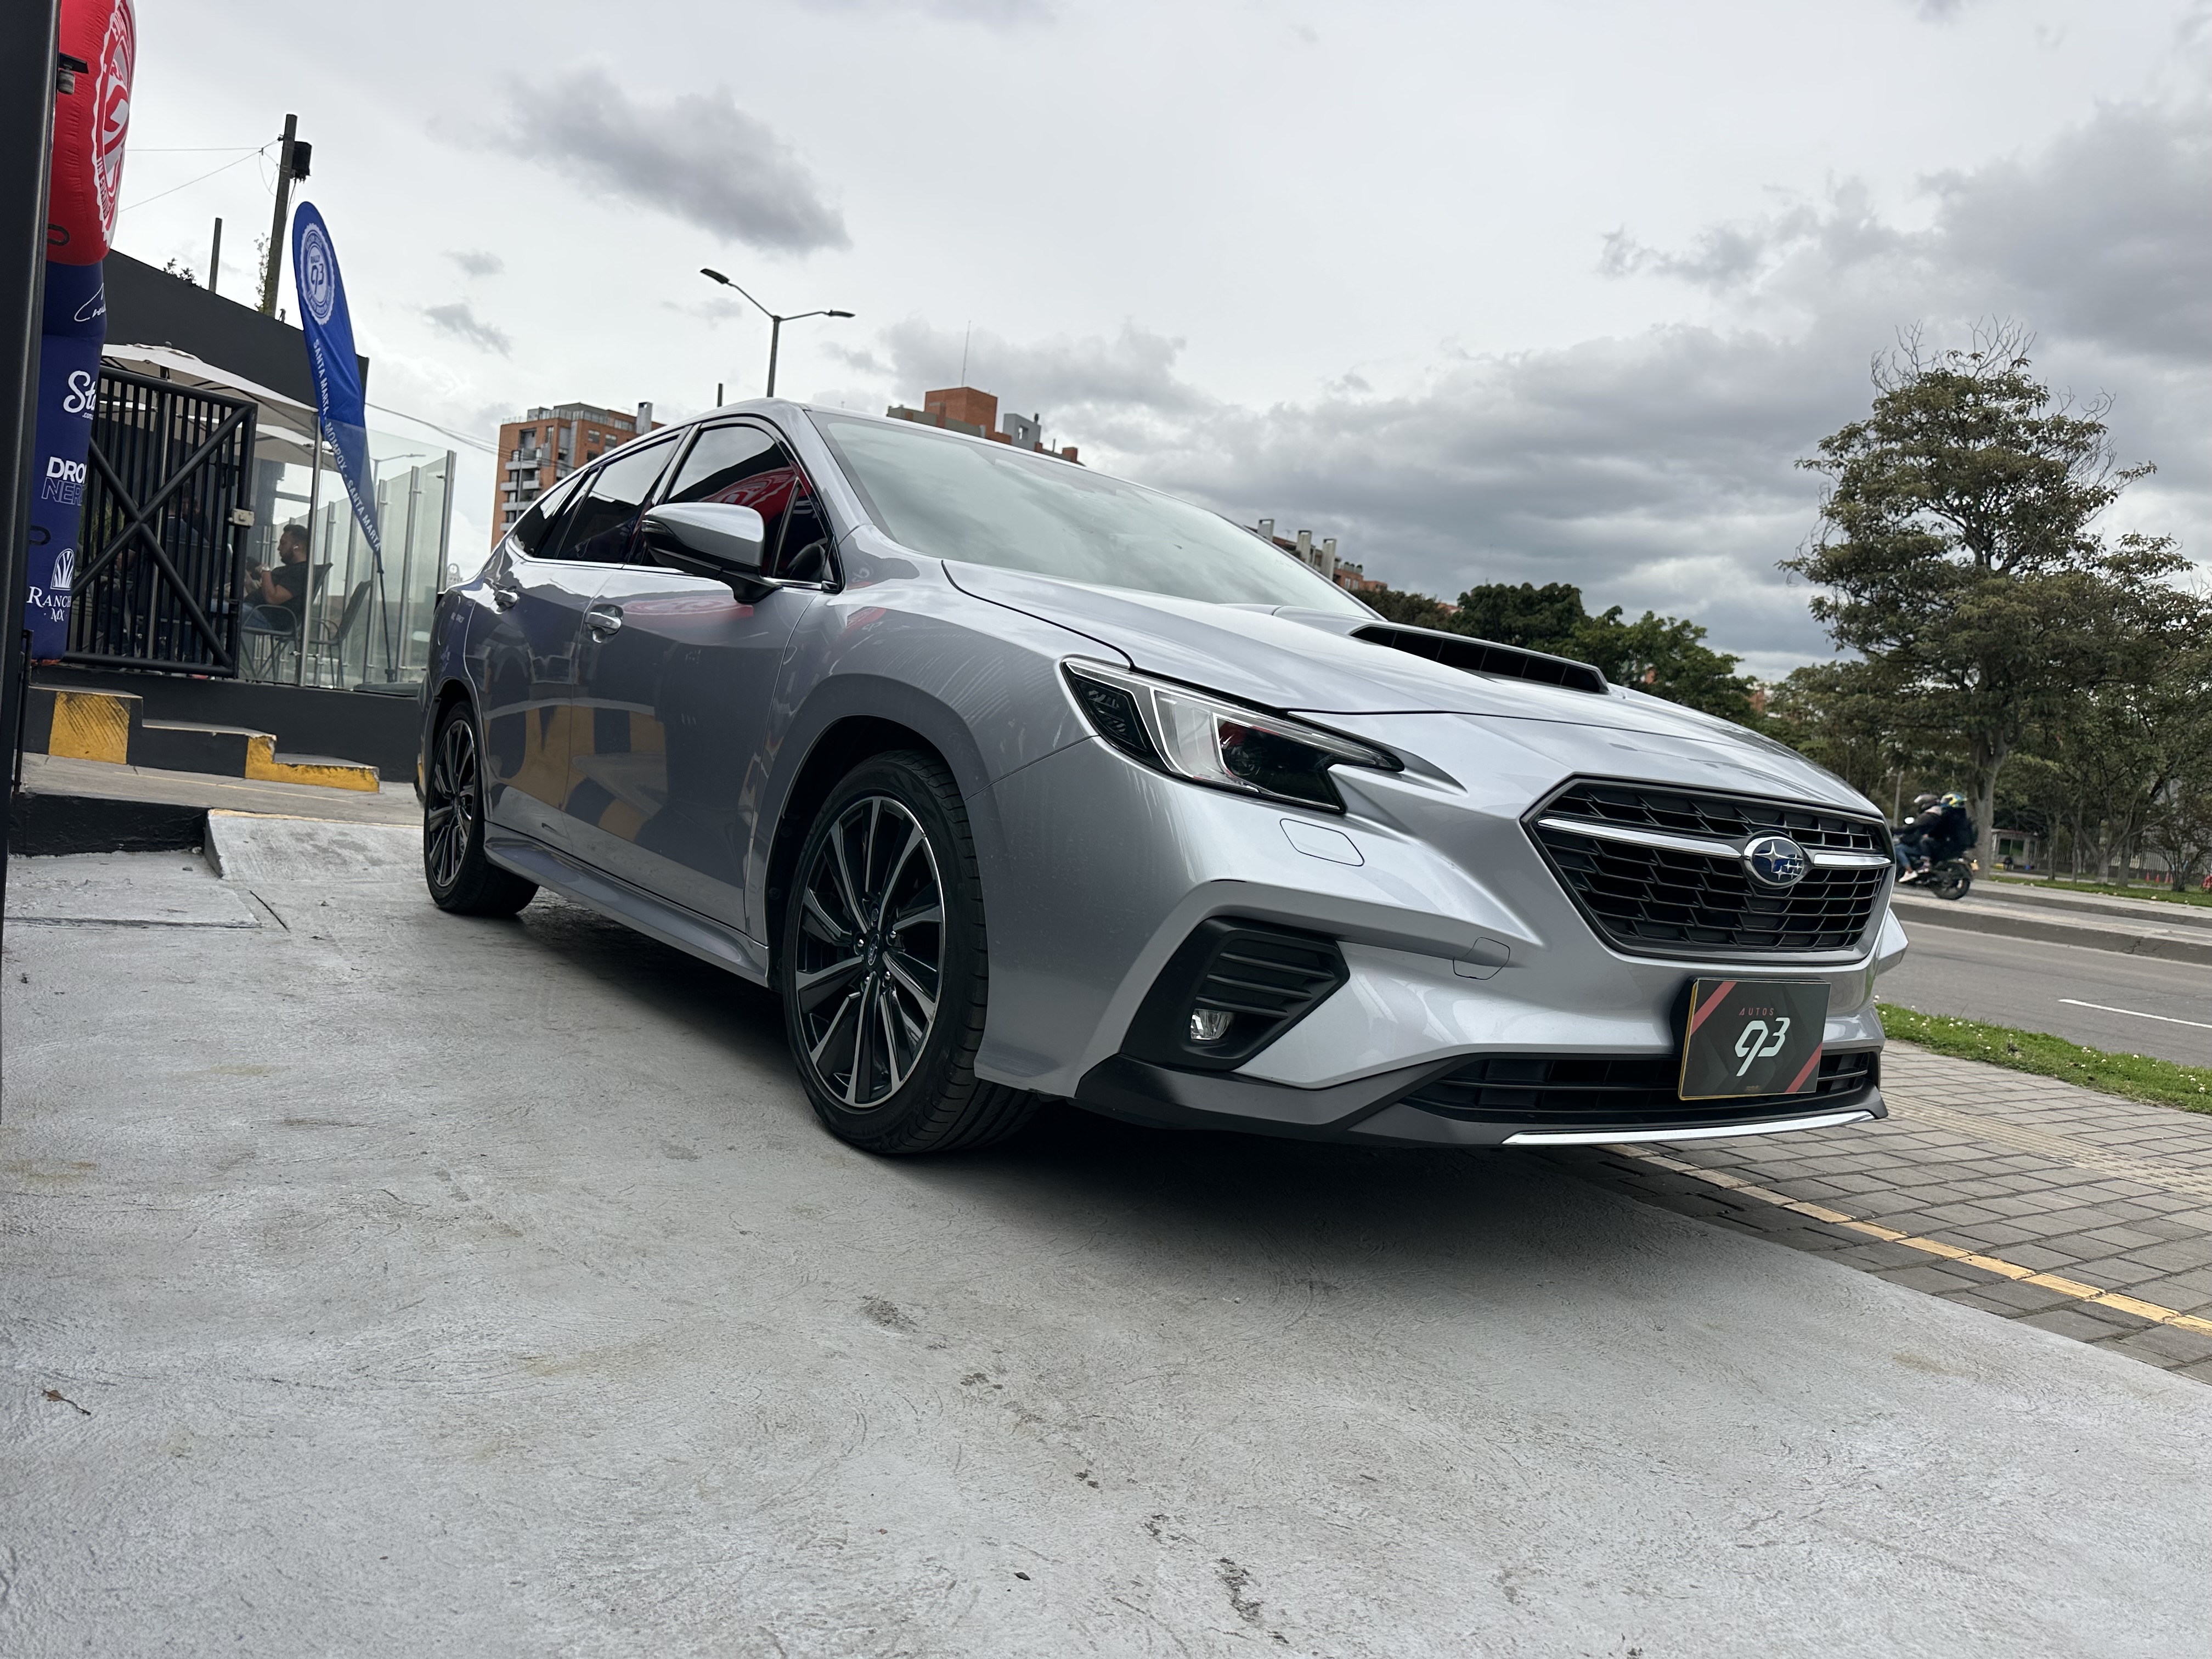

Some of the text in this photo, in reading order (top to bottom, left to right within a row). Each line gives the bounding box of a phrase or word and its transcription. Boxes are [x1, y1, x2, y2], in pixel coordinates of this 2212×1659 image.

[311, 263, 324, 296] 93
[313, 339, 382, 552] SANTA MARTA MOMPOX SANTA MARTA
[46, 456, 87, 484] DRO
[41, 477, 83, 506] NER
[1738, 1007, 1775, 1017] AUTOS
[1734, 1017, 1791, 1077] 93
